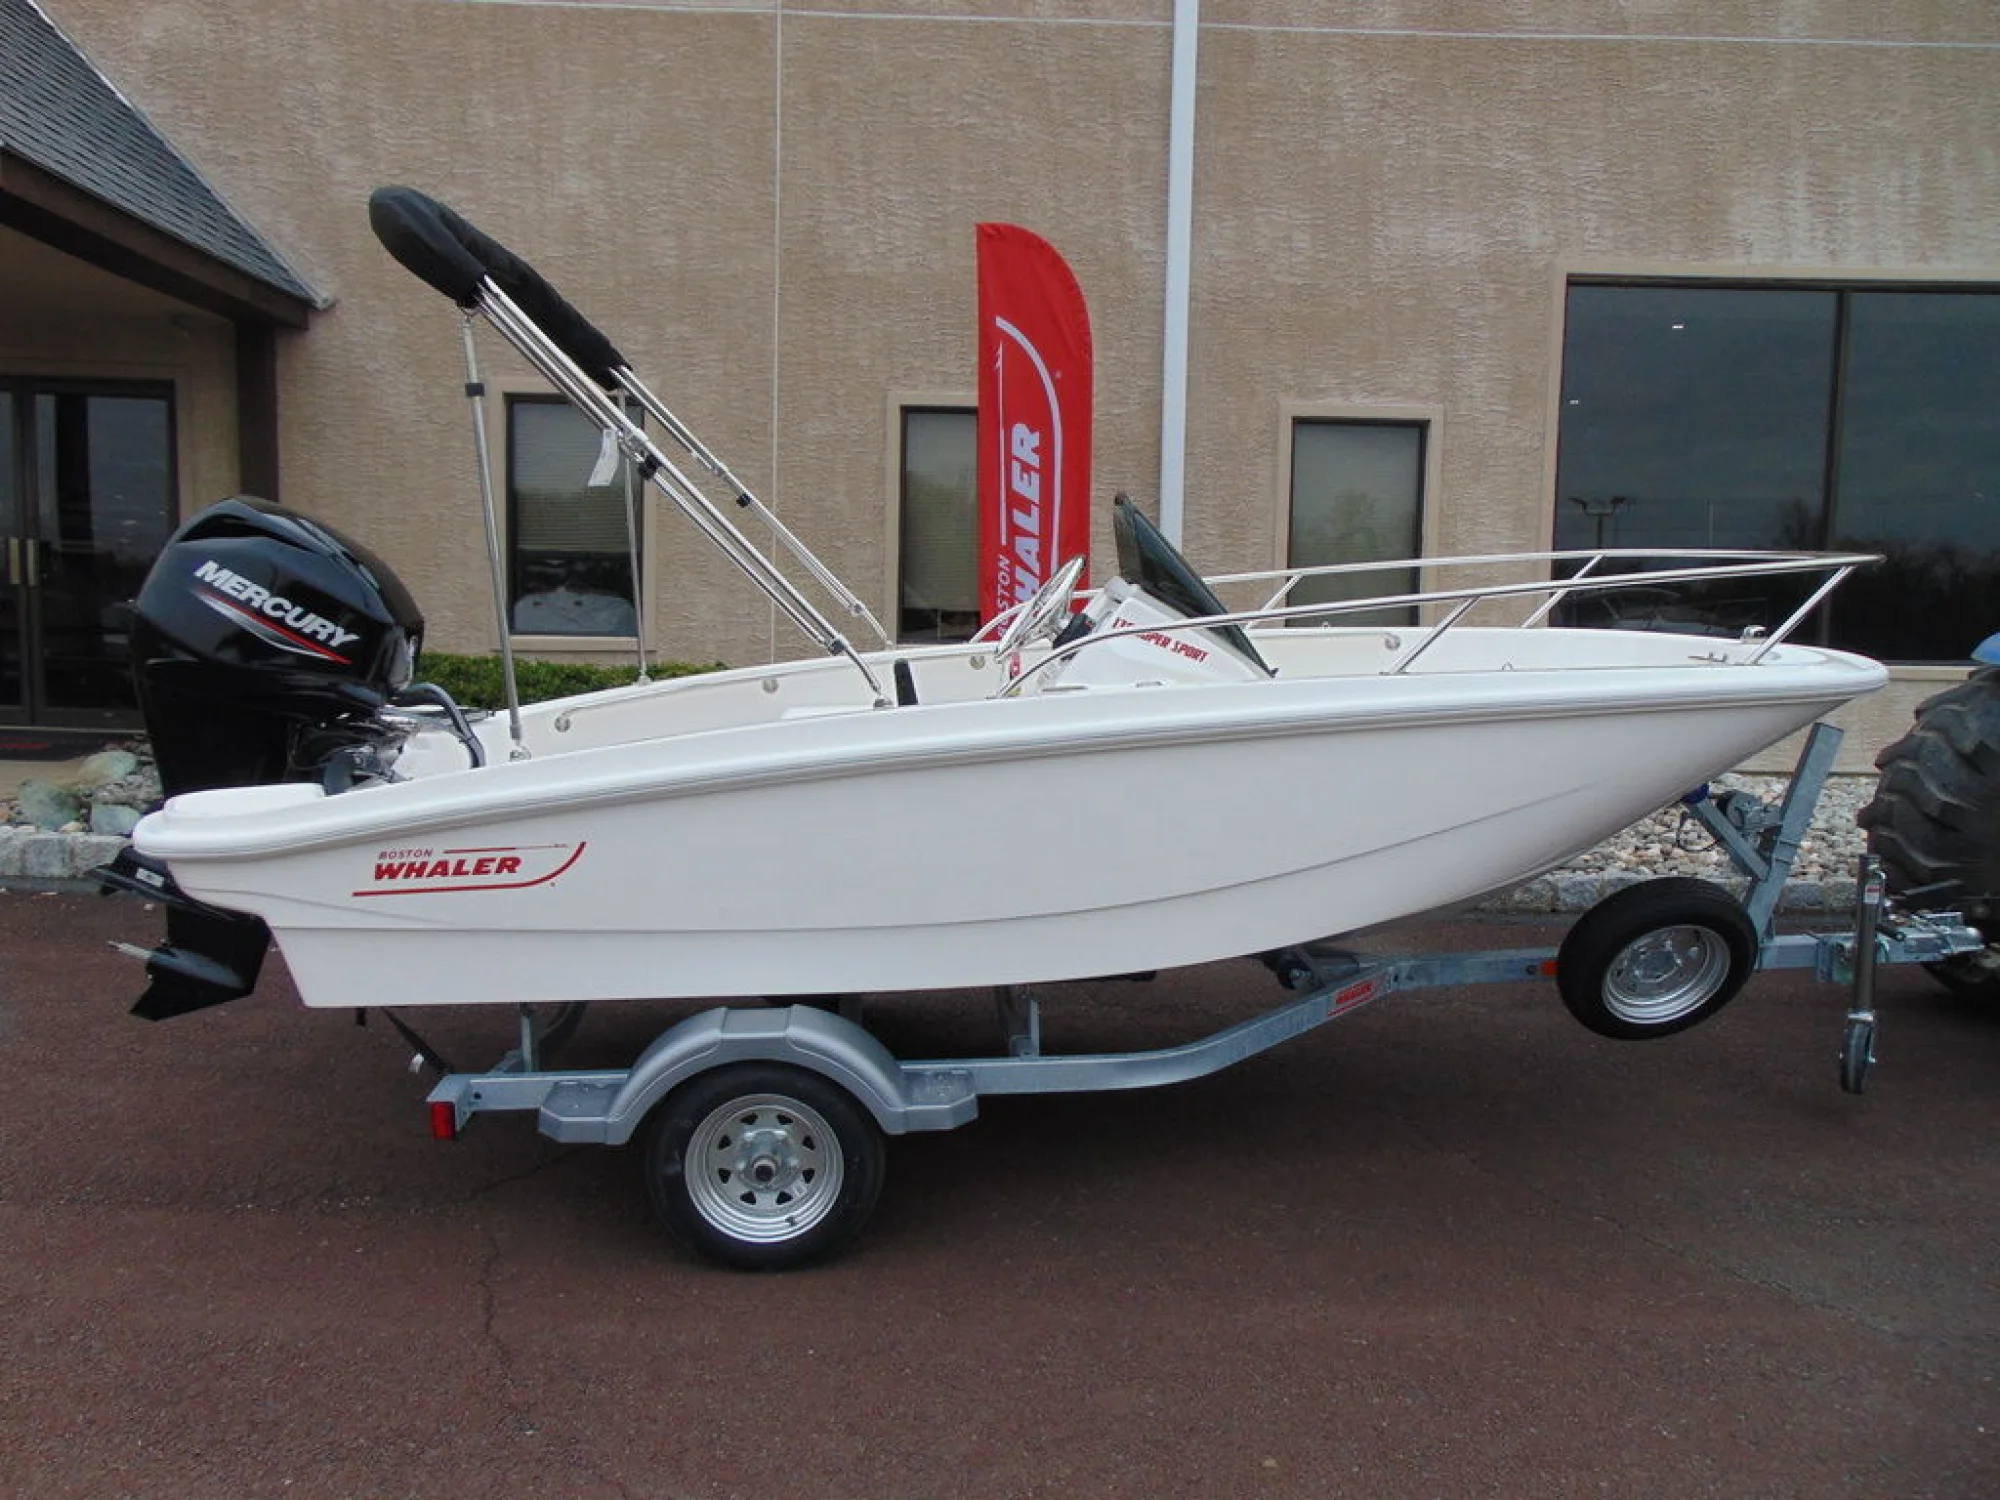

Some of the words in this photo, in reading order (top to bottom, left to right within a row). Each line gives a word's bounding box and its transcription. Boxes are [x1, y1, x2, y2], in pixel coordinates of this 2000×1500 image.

[1011, 423, 1041, 604] HALER
[194, 560, 360, 647] MERCURY
[1136, 633, 1172, 648] UPER
[1170, 640, 1209, 662] SPORT
[374, 856, 522, 880] WHALER
[378, 849, 433, 860] BOSTON
